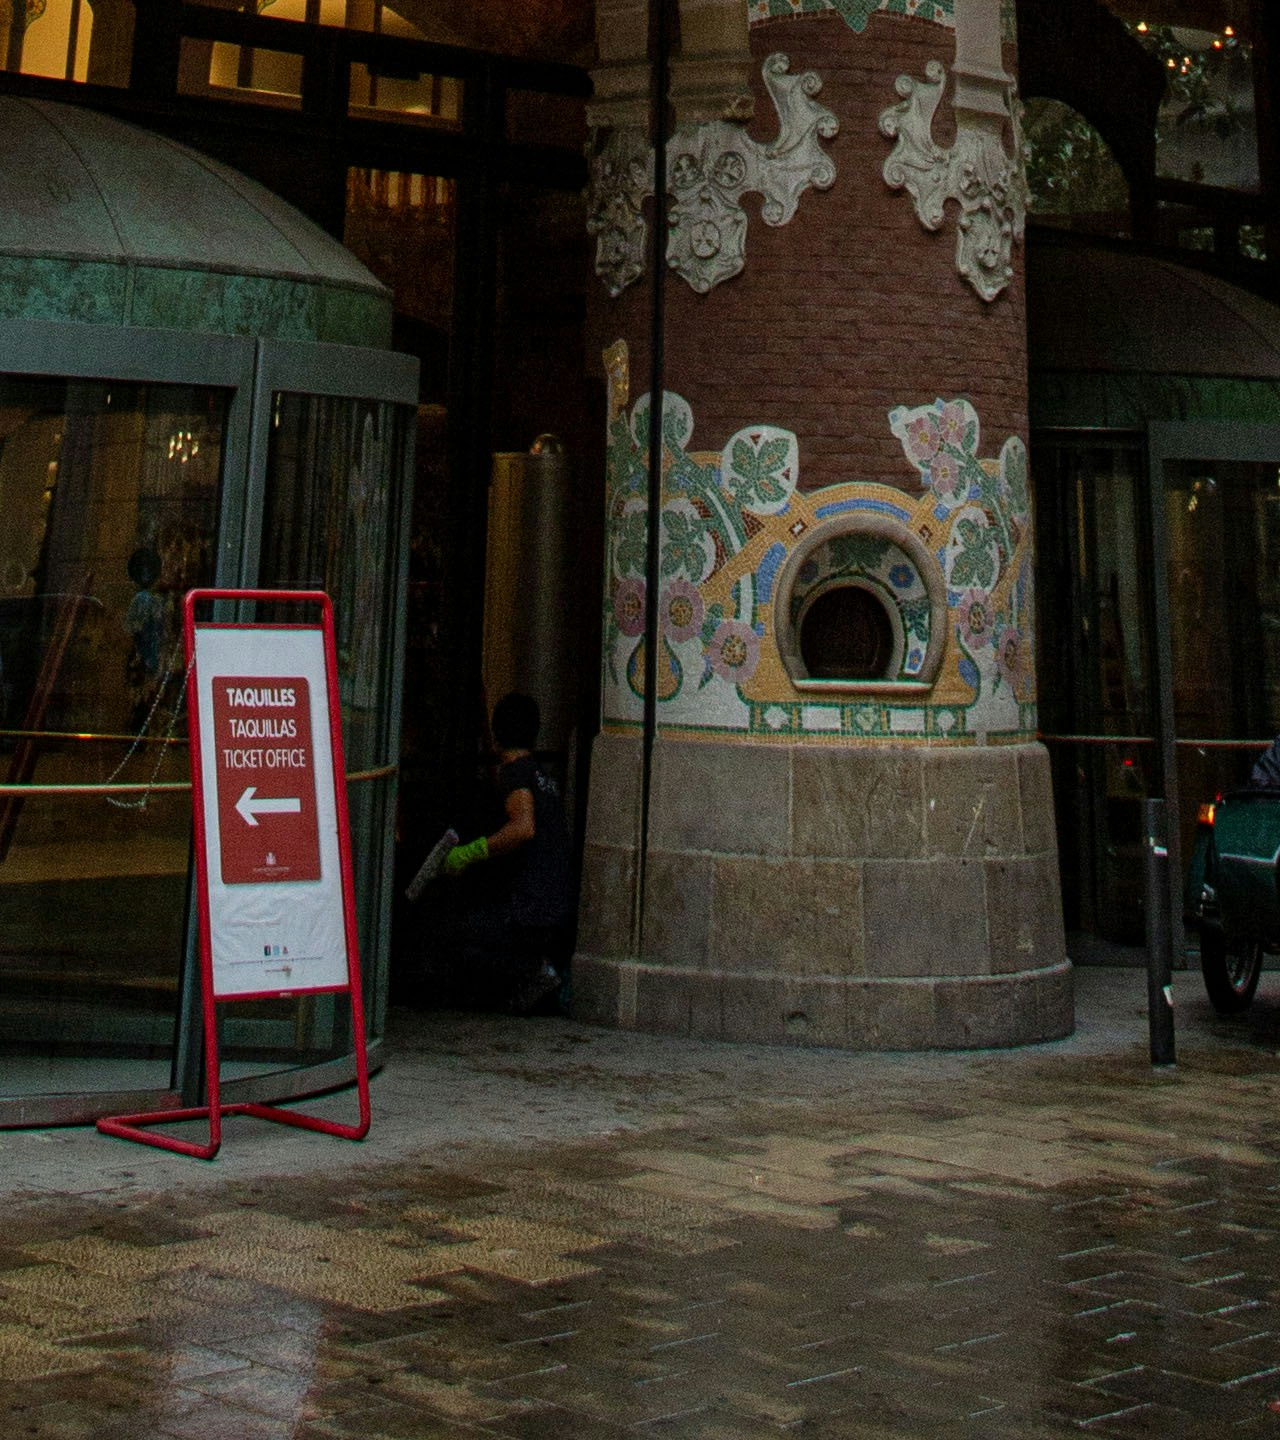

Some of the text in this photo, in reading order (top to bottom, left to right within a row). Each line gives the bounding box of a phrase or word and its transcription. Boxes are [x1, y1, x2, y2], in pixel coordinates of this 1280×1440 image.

[226, 687, 296, 708] TAQUILLES
[229, 718, 297, 738] TAQUILLAS
[223, 748, 306, 769] TICKET OFFICE
